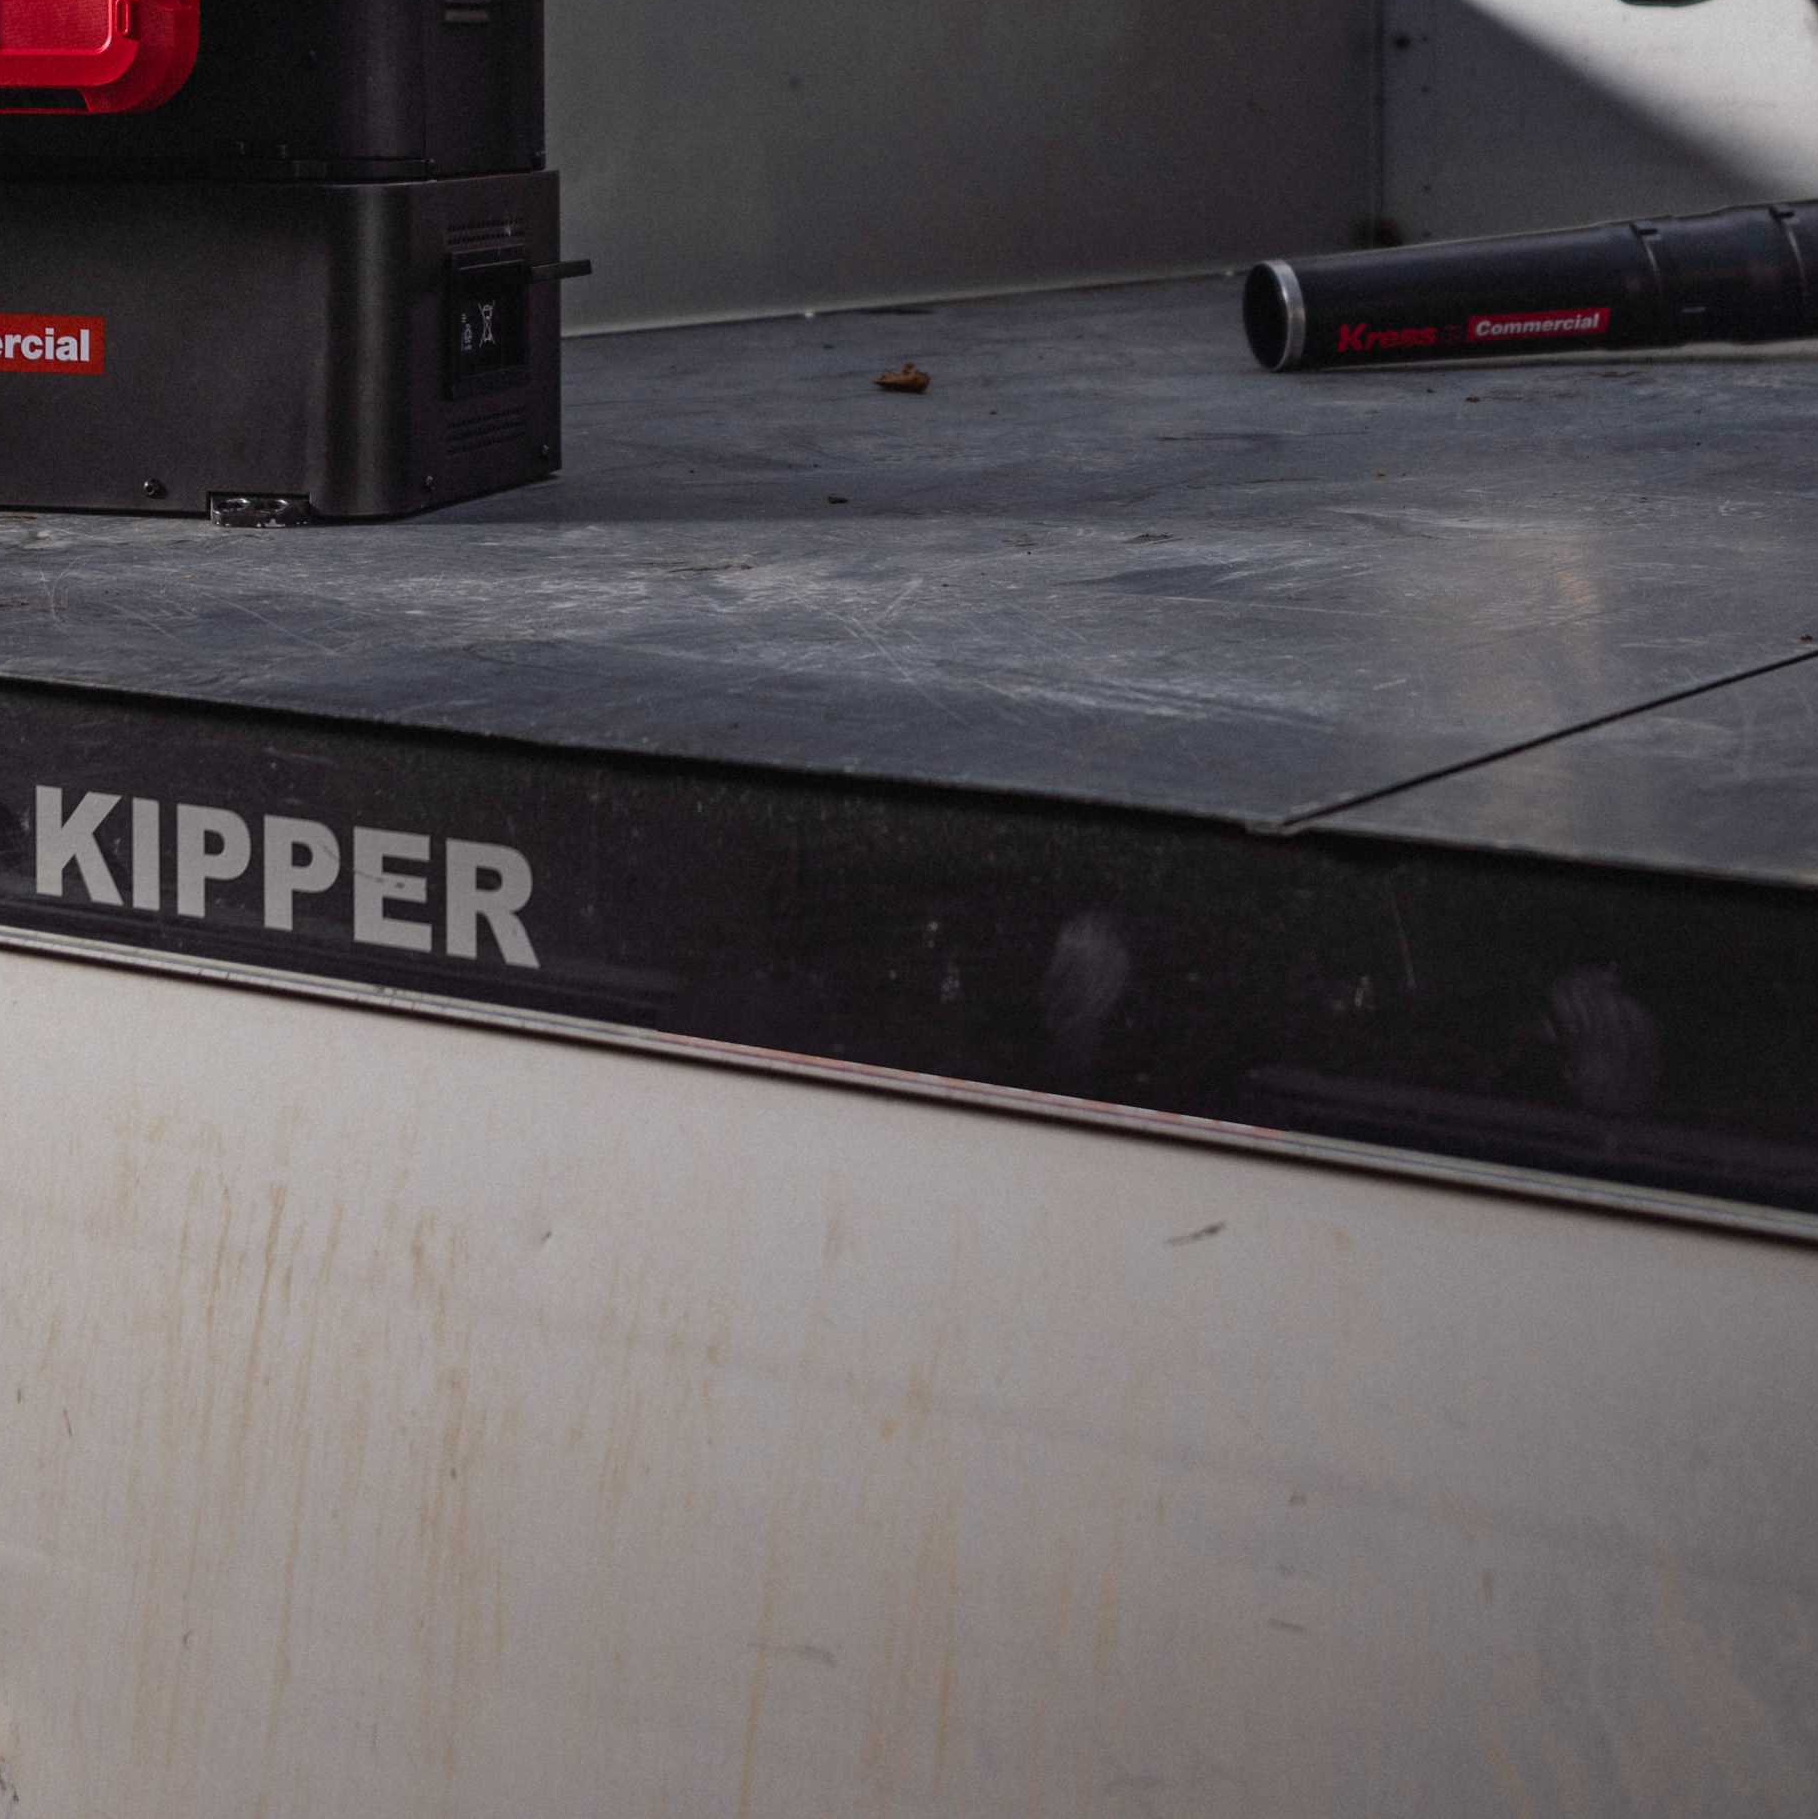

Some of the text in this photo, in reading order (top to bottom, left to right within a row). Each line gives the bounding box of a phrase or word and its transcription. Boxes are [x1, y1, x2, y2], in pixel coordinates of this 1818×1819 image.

[1337, 312, 1601, 353] Kress Commercial
[35, 784, 541, 969] KIPPER
